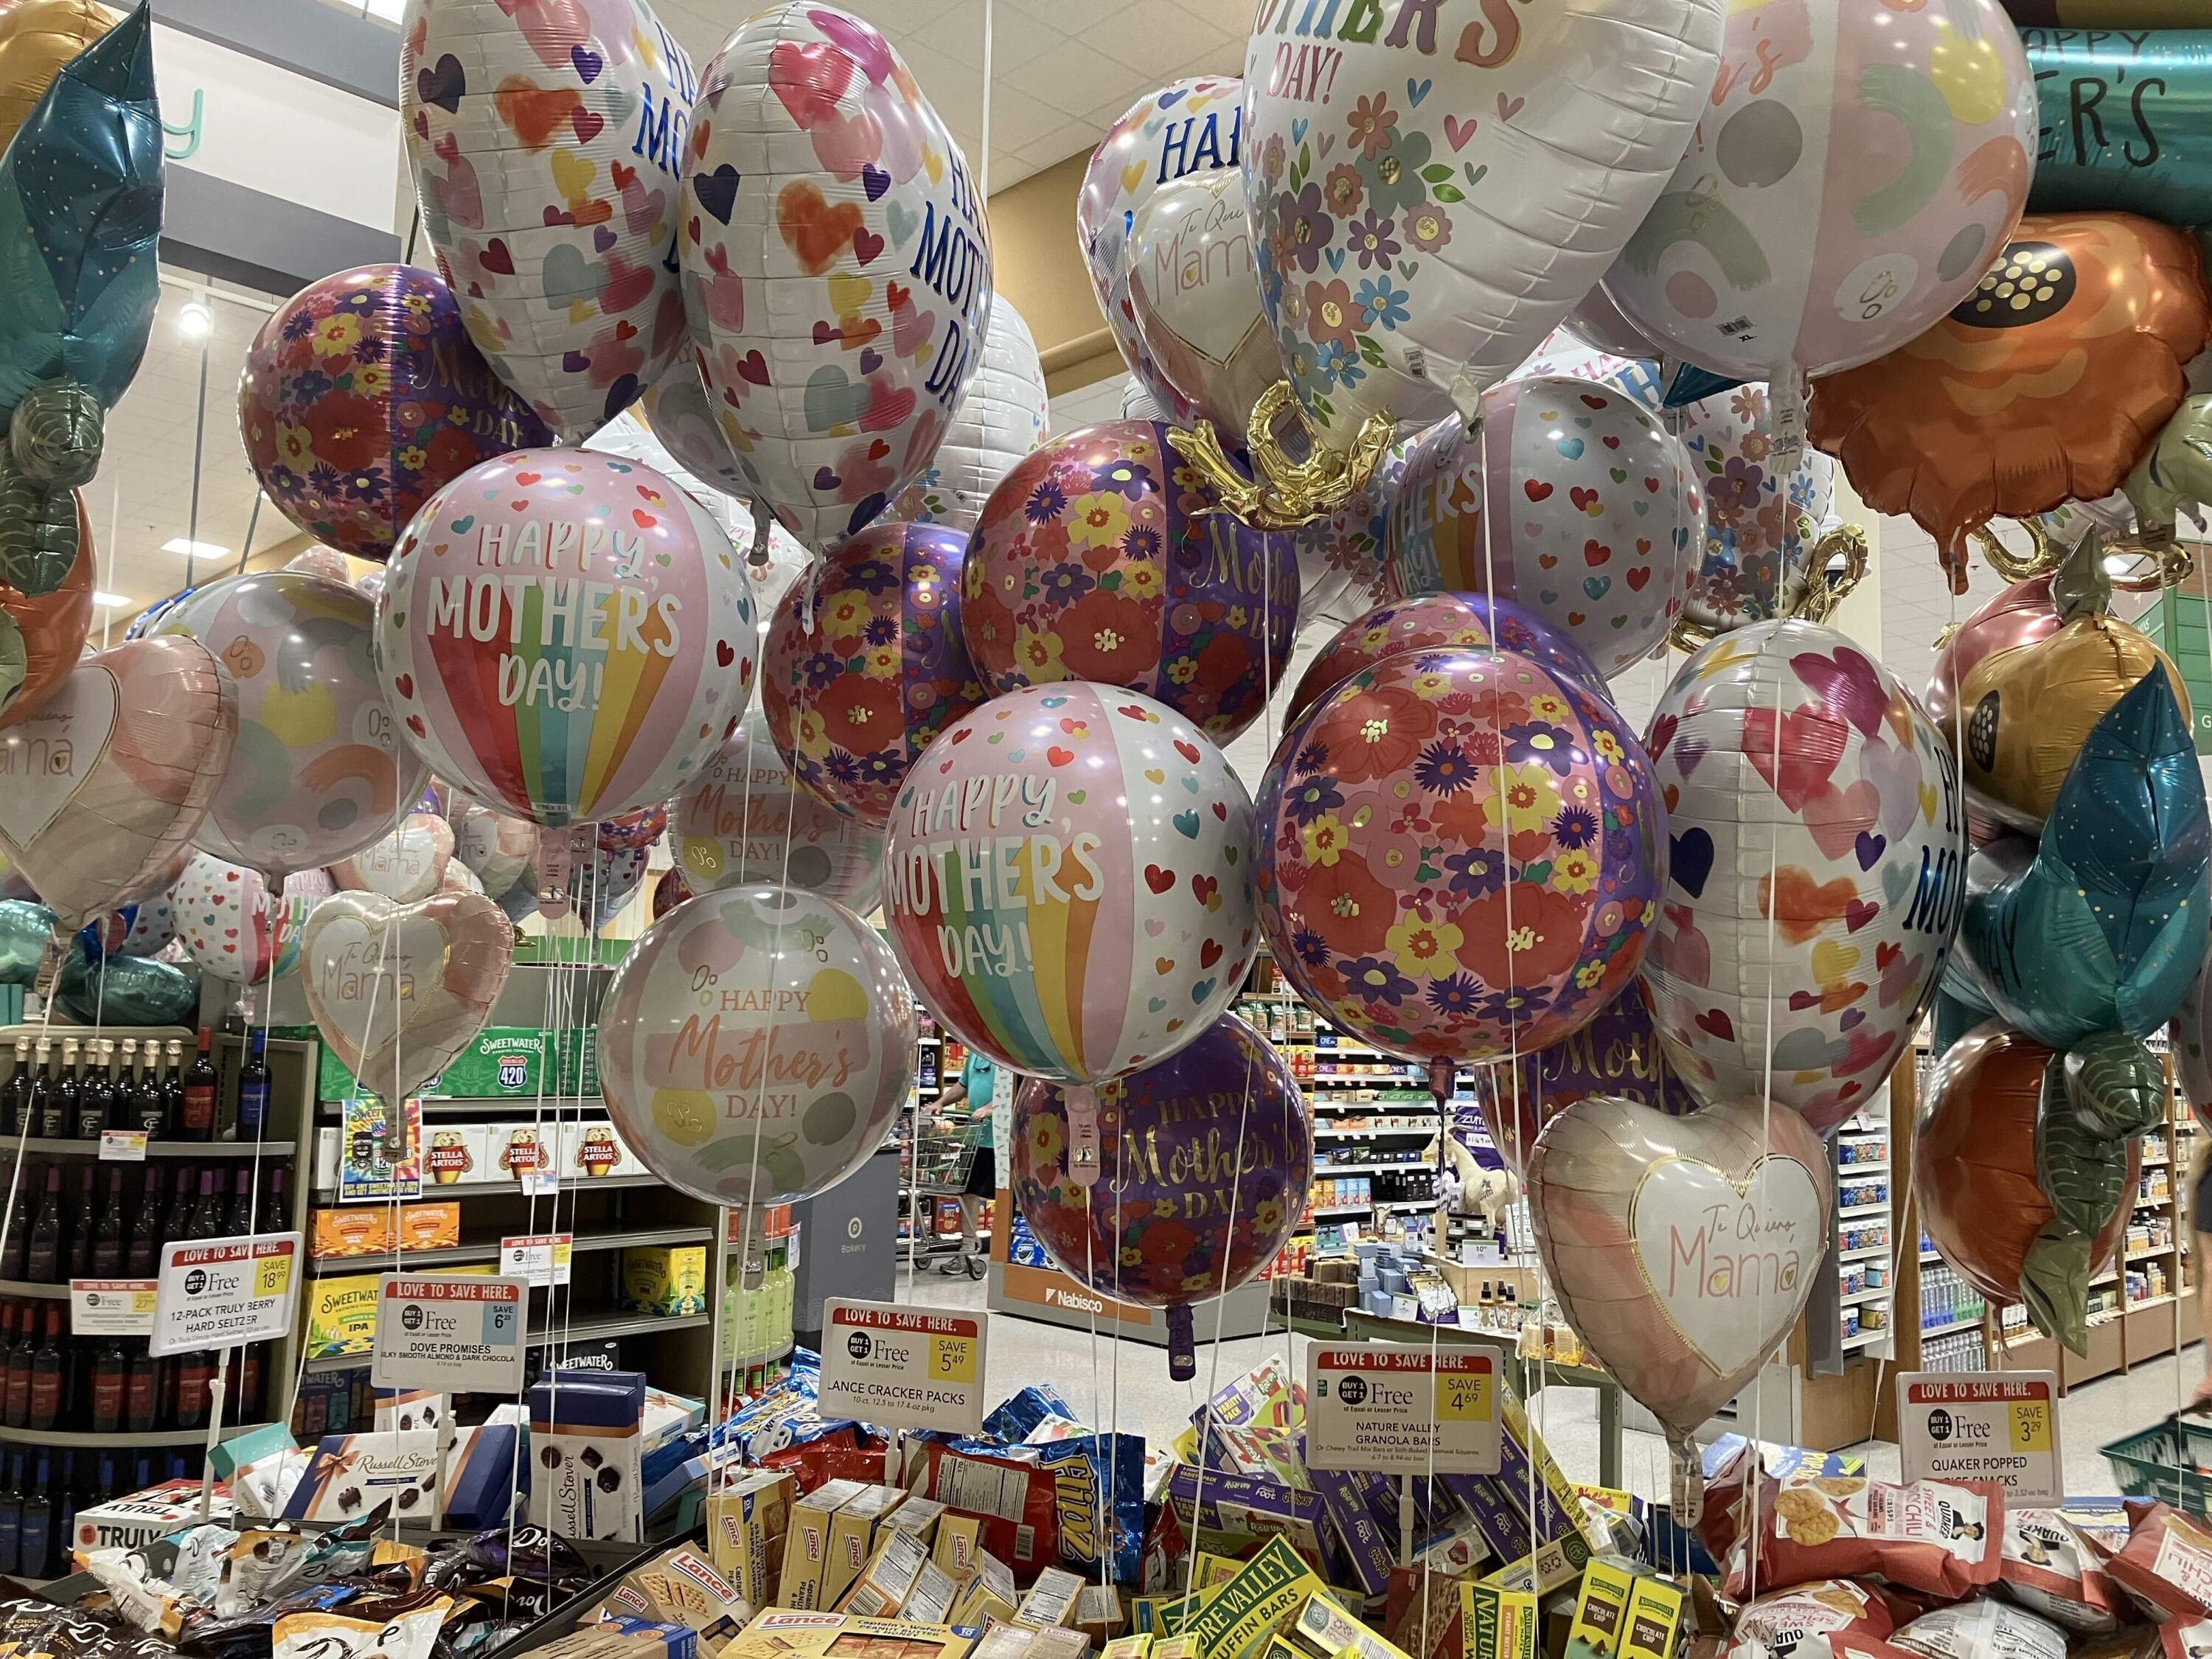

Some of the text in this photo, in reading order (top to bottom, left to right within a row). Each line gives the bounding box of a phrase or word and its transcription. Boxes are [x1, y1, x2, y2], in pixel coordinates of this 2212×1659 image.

[1266, 42, 1343, 104] DAY!
[1155, 233, 1256, 305] Mam
[478, 518, 647, 580] HAPPY
[497, 652, 606, 714] DAY!
[726, 765, 792, 787] HAPPY
[689, 782, 839, 843] Mother's
[910, 771, 1060, 839] HAPPY
[729, 839, 783, 863] DAY!
[344, 941, 363, 965] Te
[935, 920, 1036, 979] DAY!
[322, 953, 416, 1002] Mamá
[718, 988, 811, 1013] HAPPY
[479, 1037, 544, 1055] SWEETWATER
[667, 1012, 855, 1091] Mother's
[501, 1066, 524, 1085] 420
[724, 1094, 796, 1121] DAY!
[1156, 1088, 1259, 1126] HAPPY
[431, 1151, 465, 1160] STELLA
[583, 1145, 613, 1154] STELLA
[583, 1152, 614, 1161] ARTOIS
[1109, 1125, 1298, 1194] Mother's
[430, 1158, 465, 1167] ARTOIS
[1183, 1185, 1251, 1221] DAY
[1703, 1203, 1729, 1243] Te
[184, 1242, 280, 1262] LOVE TO HERE.
[841, 1243, 867, 1254] Bakery
[262, 1260, 287, 1271] SAVE
[1668, 1224, 1801, 1300] Mamá
[209, 1273, 240, 1292] Free
[398, 1283, 512, 1300] LOVE TO SAVE HERE.
[100, 1296, 122, 1307] Free
[171, 1298, 276, 1322] 12-PACK TRULY BERRY
[321, 1289, 379, 1315] SWEETWAT
[493, 1306, 514, 1314] SAVE
[1056, 1288, 1104, 1314] Nabisco
[185, 1315, 258, 1334] HARD SELTZER
[348, 1322, 369, 1333] IPA
[425, 1311, 457, 1330] Free
[845, 1308, 958, 1332] LOVE TO SAVE HERE.
[410, 1342, 491, 1354] DOVE PROMISES
[849, 1345, 864, 1353] GET
[850, 1336, 864, 1345] BUY
[874, 1339, 910, 1363] Free
[939, 1340, 968, 1354] SAVE
[398, 1352, 426, 1360] SMOOTH
[426, 1352, 454, 1360] ALMOND
[1333, 1352, 1469, 1369] LOVE TO SAVE HERE.
[867, 1383, 923, 1401] CRACKER
[926, 1390, 966, 1406] PACKS
[1342, 1382, 1358, 1390] BUY
[1342, 1391, 1358, 1399] GET
[1371, 1382, 1413, 1405] Free
[1447, 1379, 1482, 1391] SAVE
[1921, 1382, 2032, 1399] LOVE TO SAVE HERE.
[922, 1404, 935, 1413] pkg
[1217, 1393, 1242, 1416] VARIETY
[1223, 1407, 1242, 1423] PACK
[2016, 1406, 2043, 1419] SAVE
[1355, 1422, 1441, 1433] NATURE VALLEY
[1930, 1416, 1944, 1424] BUY
[1930, 1426, 1945, 1434] GET
[1955, 1415, 1991, 1439] Free
[1355, 1435, 1441, 1447] GRANOLA BARS
[356, 1451, 439, 1475] Russell Stove
[1931, 1456, 2028, 1472] QUAKER POPPED
[558, 1454, 575, 1503] Stover
[1254, 1489, 1277, 1500] Foot
[1922, 1486, 1935, 1521] SWEET
[1493, 1512, 1511, 1536] Foot
[1905, 1503, 1923, 1537] CHILI
[1938, 1500, 1952, 1540] QUAKER
[726, 1516, 740, 1547] Lance
[1354, 1519, 1372, 1545] Foot
[807, 1528, 818, 1560] Lance
[849, 1535, 861, 1568] Lance
[956, 1535, 967, 1568] Lance
[676, 1554, 734, 1601] Lance
[617, 1588, 646, 1610] Lance
[1196, 1544, 1298, 1649] URE VALLEY
[1259, 1587, 1300, 1622] BARS
[763, 1614, 841, 1627] Lance
[1587, 1602, 1616, 1621] CHOCOLATE
[1593, 1613, 1607, 1623] CHIP
[857, 1620, 947, 1633] Captain's Wafers
[858, 1625, 940, 1637] PEANUT BUTTER
[882, 1630, 919, 1638] HONEY
[1635, 1623, 1665, 1641] CHOCOLATE
[1641, 1632, 1655, 1644] CHIP
